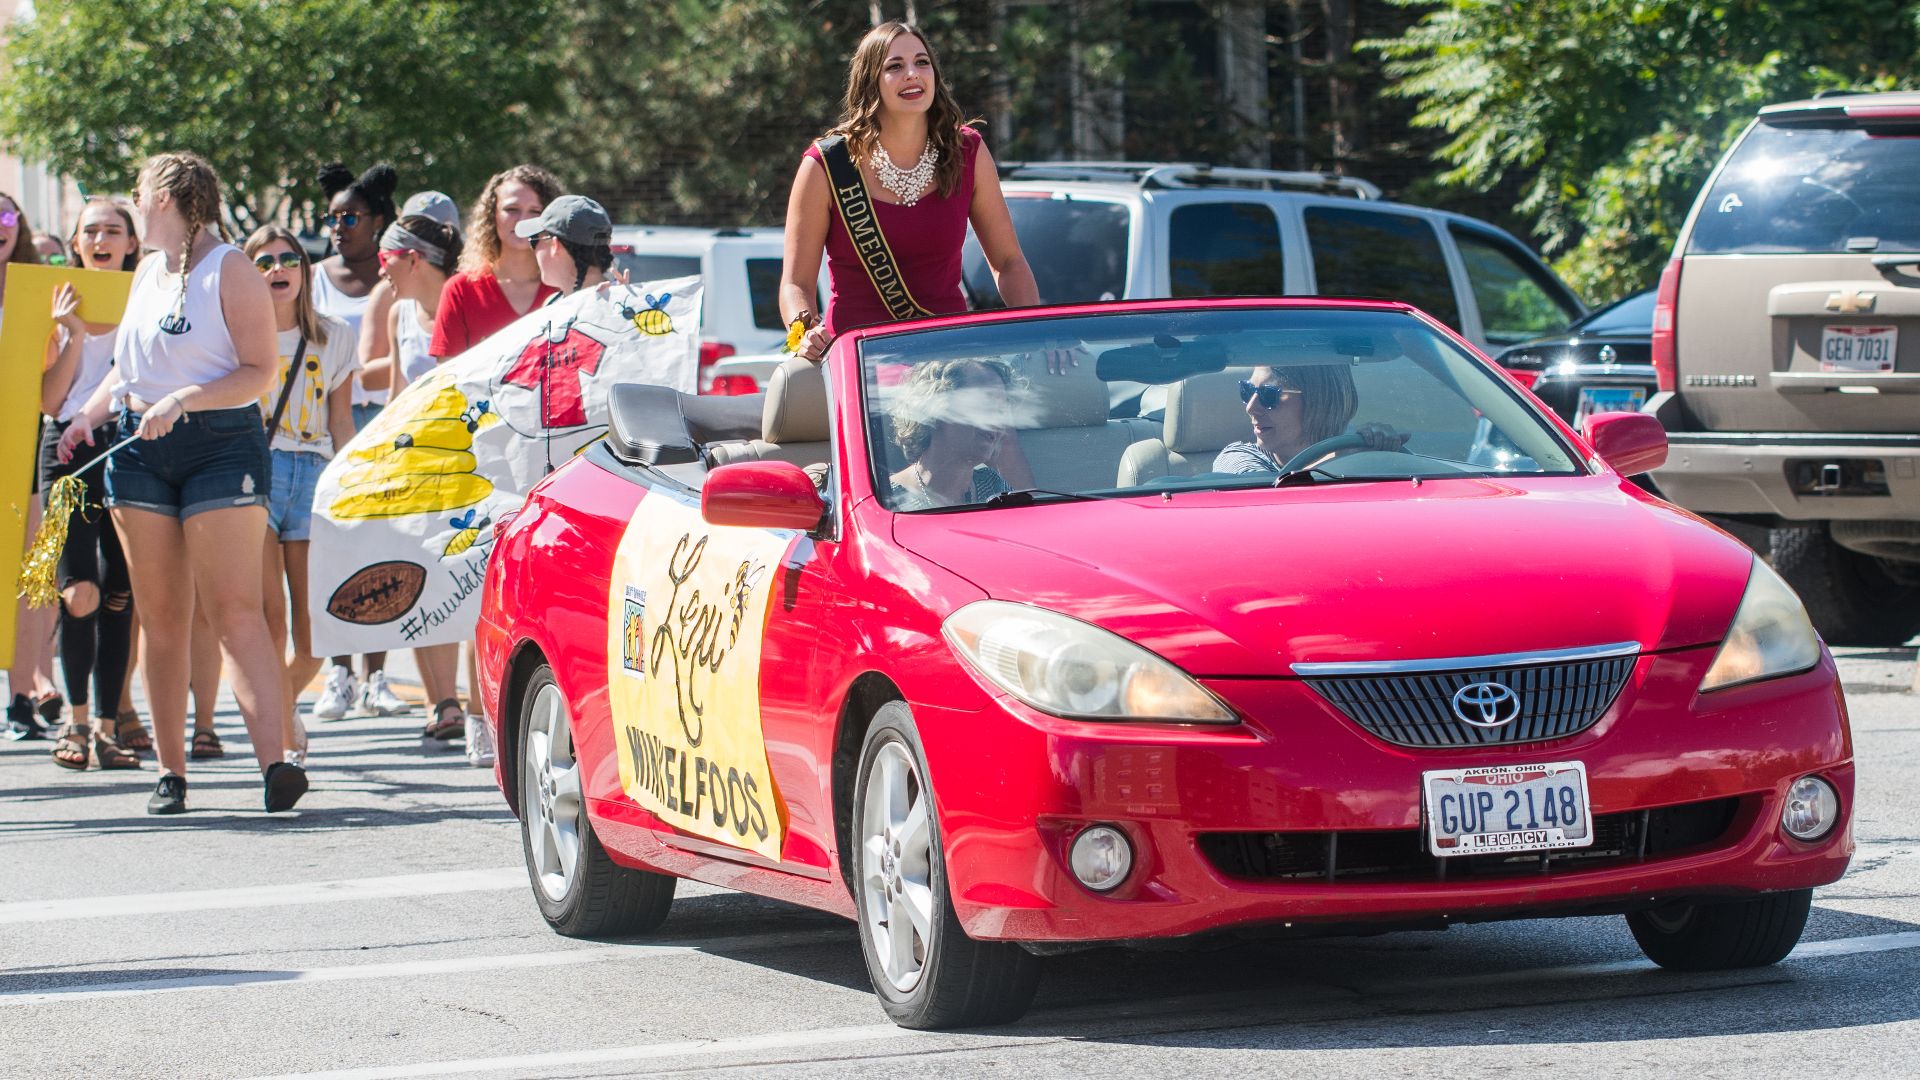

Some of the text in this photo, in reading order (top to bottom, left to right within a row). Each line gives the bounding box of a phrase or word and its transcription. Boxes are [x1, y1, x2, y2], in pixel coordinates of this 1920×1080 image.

[1826, 337, 1889, 361] GEH 7031
[1515, 764, 1546, 772] OHIO
[625, 724, 769, 842] WINKELFOOS
[1485, 773, 1524, 785] OHIO
[1440, 786, 1577, 835] GUP 2148
[1474, 831, 1548, 847] LEGACY
[1451, 846, 1505, 854] MOTORS
[1531, 841, 1575, 849] AKRON
